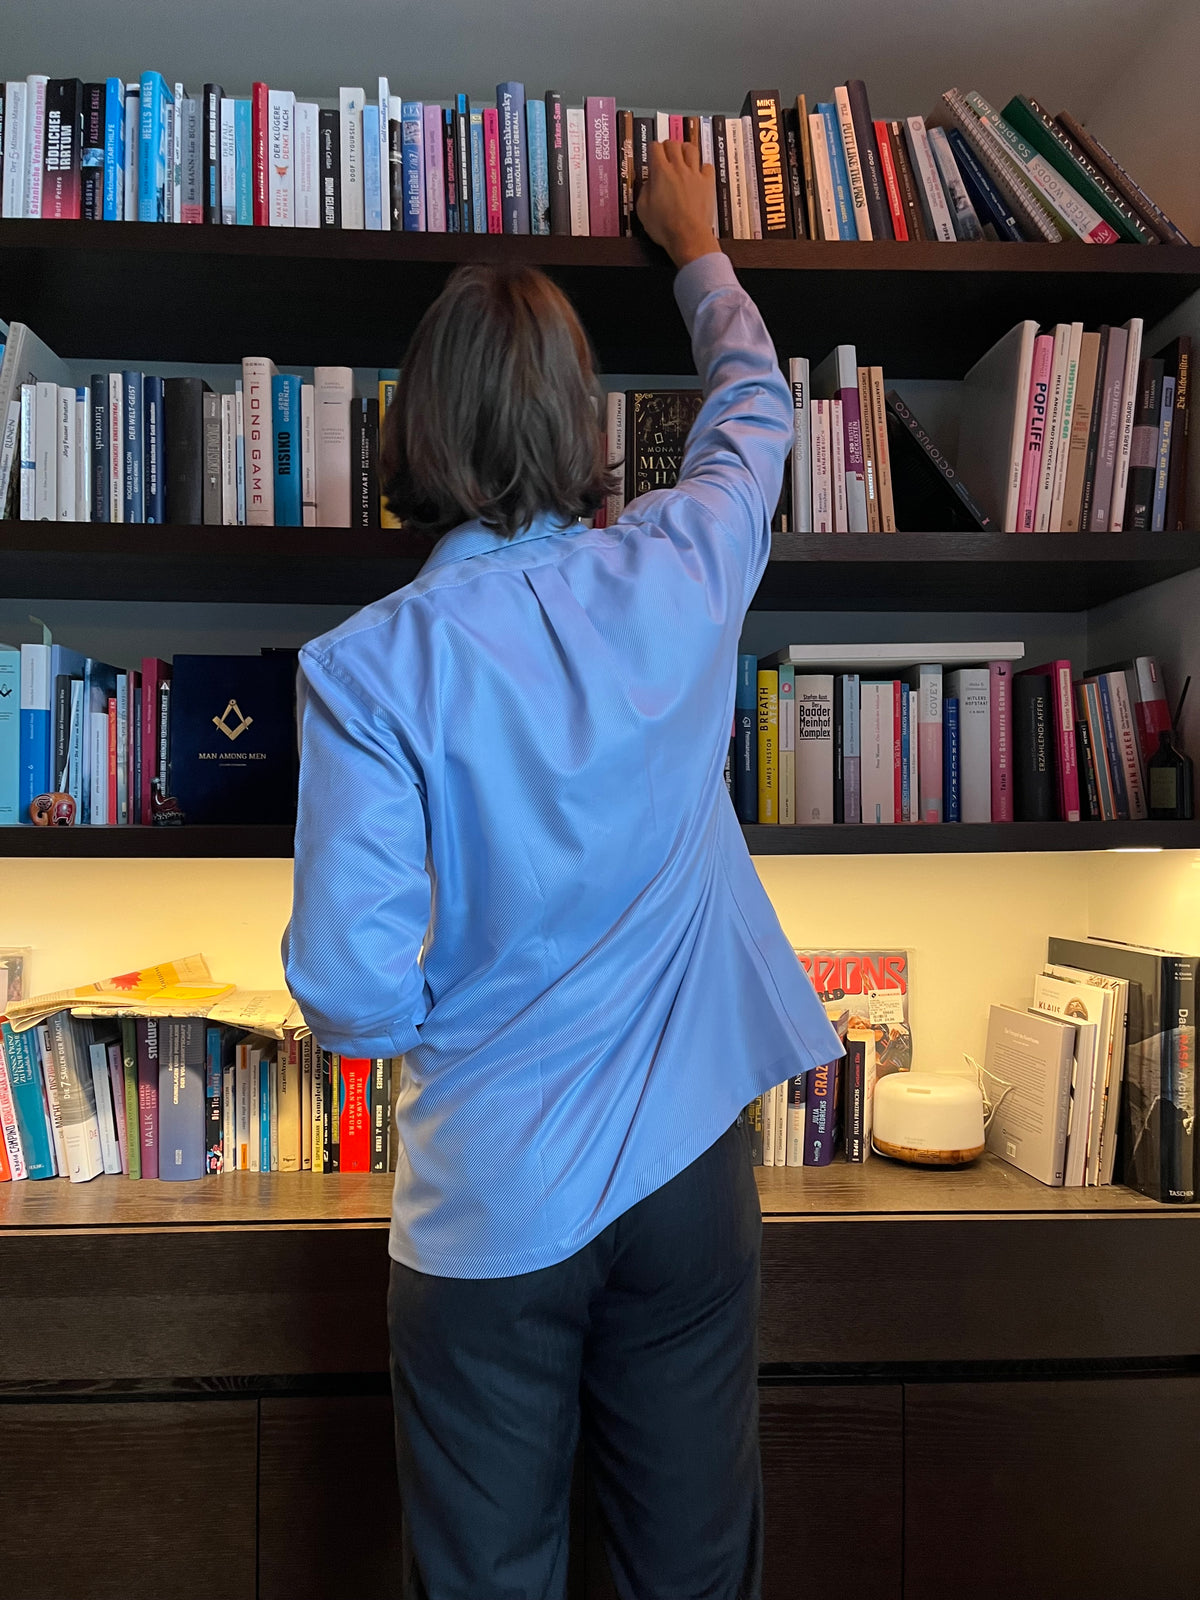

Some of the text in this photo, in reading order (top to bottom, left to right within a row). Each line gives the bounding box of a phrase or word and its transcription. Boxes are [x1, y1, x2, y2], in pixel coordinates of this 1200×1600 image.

[142, 80, 153, 139] HELL'S ANGEL
[756, 99, 775, 107] MIKE
[973, 96, 991, 114] ich!
[46, 110, 61, 171] TÖDLICHER
[90, 111, 99, 144] FALSCHER
[187, 115, 195, 139] BUCH
[511, 111, 520, 144] ÜBERALL
[553, 102, 562, 149] Türken-Sam
[594, 118, 603, 160] GRUNDLOS
[601, 113, 610, 160] ERSCHÖPFT?
[991, 113, 1018, 141] spiele
[30, 81, 44, 215] Satanische Verhandlungskunst
[60, 125, 72, 170] IRRTUM
[349, 154, 355, 162] IT
[488, 139, 496, 166] Medizin
[502, 93, 514, 197] Heinz Buschkowsky
[569, 122, 581, 170] what if?
[867, 149, 875, 166] GOLF
[1018, 143, 1031, 159] So
[513, 158, 522, 197] NEUKÖLLN
[757, 105, 786, 231] TYSON TRUTH!
[842, 123, 865, 208] PUTT LIKE THE PROS
[1032, 163, 1064, 198] WOODS
[54, 176, 63, 200] Peters
[106, 166, 115, 200] Sketchnote
[408, 170, 420, 215] Große Freiheit
[491, 186, 499, 211] Mythos
[941, 222, 950, 240] PIPER
[1066, 201, 1092, 230] TIGER
[128, 384, 136, 428] WELT-GEIST
[794, 383, 803, 408] PIPER
[1176, 396, 1185, 410] Die
[1029, 382, 1047, 452] POP LIFE
[1125, 401, 1133, 423] BOARD
[5, 418, 15, 449] RUNEN
[94, 406, 104, 450] Eurotrash
[128, 427, 136, 440] DER
[895, 402, 954, 478] OCTOPUS & CO
[1124, 424, 1131, 434] ON
[1162, 420, 1171, 436] Der
[251, 385, 262, 504] LONG GAME
[277, 432, 291, 476] RISIKO
[1048, 425, 1056, 471] MOTORCYCLE
[1160, 457, 1167, 468] an
[1158, 470, 1168, 489] dem
[759, 687, 769, 731] BREATH
[768, 694, 777, 725] ATEM
[799, 704, 830, 717] Baader
[930, 681, 938, 717] COVEY
[799, 717, 831, 728] Meinhof
[799, 727, 831, 739] Komplex
[1036, 696, 1046, 772] ERZÄHLENDE AFFEN
[198, 752, 267, 760] MAN AMONG MEN
[1123, 731, 1136, 769] BECKER
[1038, 1001, 1060, 1014] KLAUS
[54, 1019, 62, 1042] MACHT
[7, 1034, 20, 1085] ALFONSO PRINZ
[14, 1034, 25, 1073] HOHENLOHE
[58, 1056, 68, 1080] SÄULEN
[1177, 1008, 1189, 1109] Das NASA Archiv
[62, 1088, 71, 1099] DIE
[814, 1065, 828, 1096] CRAZ
[52, 1103, 63, 1129] MACHT
[314, 1082, 322, 1122] Komplett
[818, 1100, 827, 1134] FRIEDRICHS
[7, 1124, 20, 1155] CAMPINO
[145, 1113, 153, 1147] MALIK
[356, 1119, 362, 1130] OF
[1168, 1188, 1194, 1197] TASCHEN
